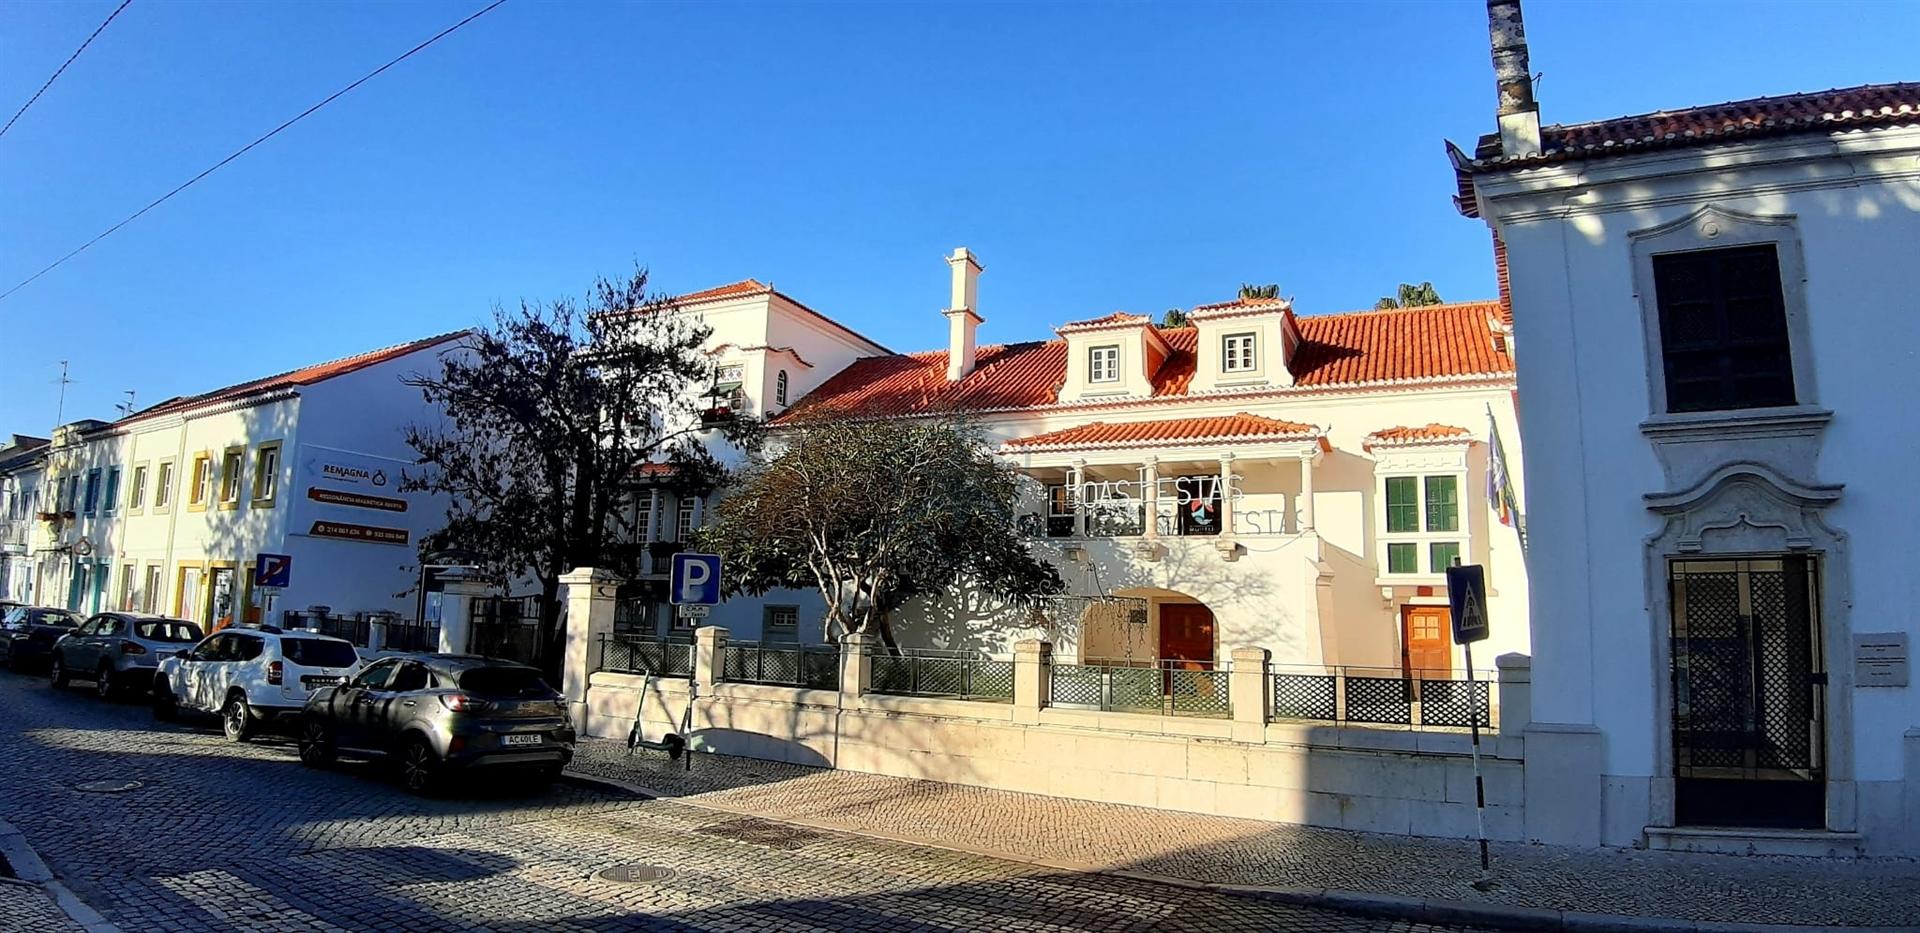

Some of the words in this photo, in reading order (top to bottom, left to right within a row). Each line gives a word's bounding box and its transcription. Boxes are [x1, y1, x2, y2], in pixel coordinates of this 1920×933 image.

[323, 464, 370, 479] REMAGNA
[1136, 466, 1245, 506] FESTAS
[682, 559, 711, 600] P
